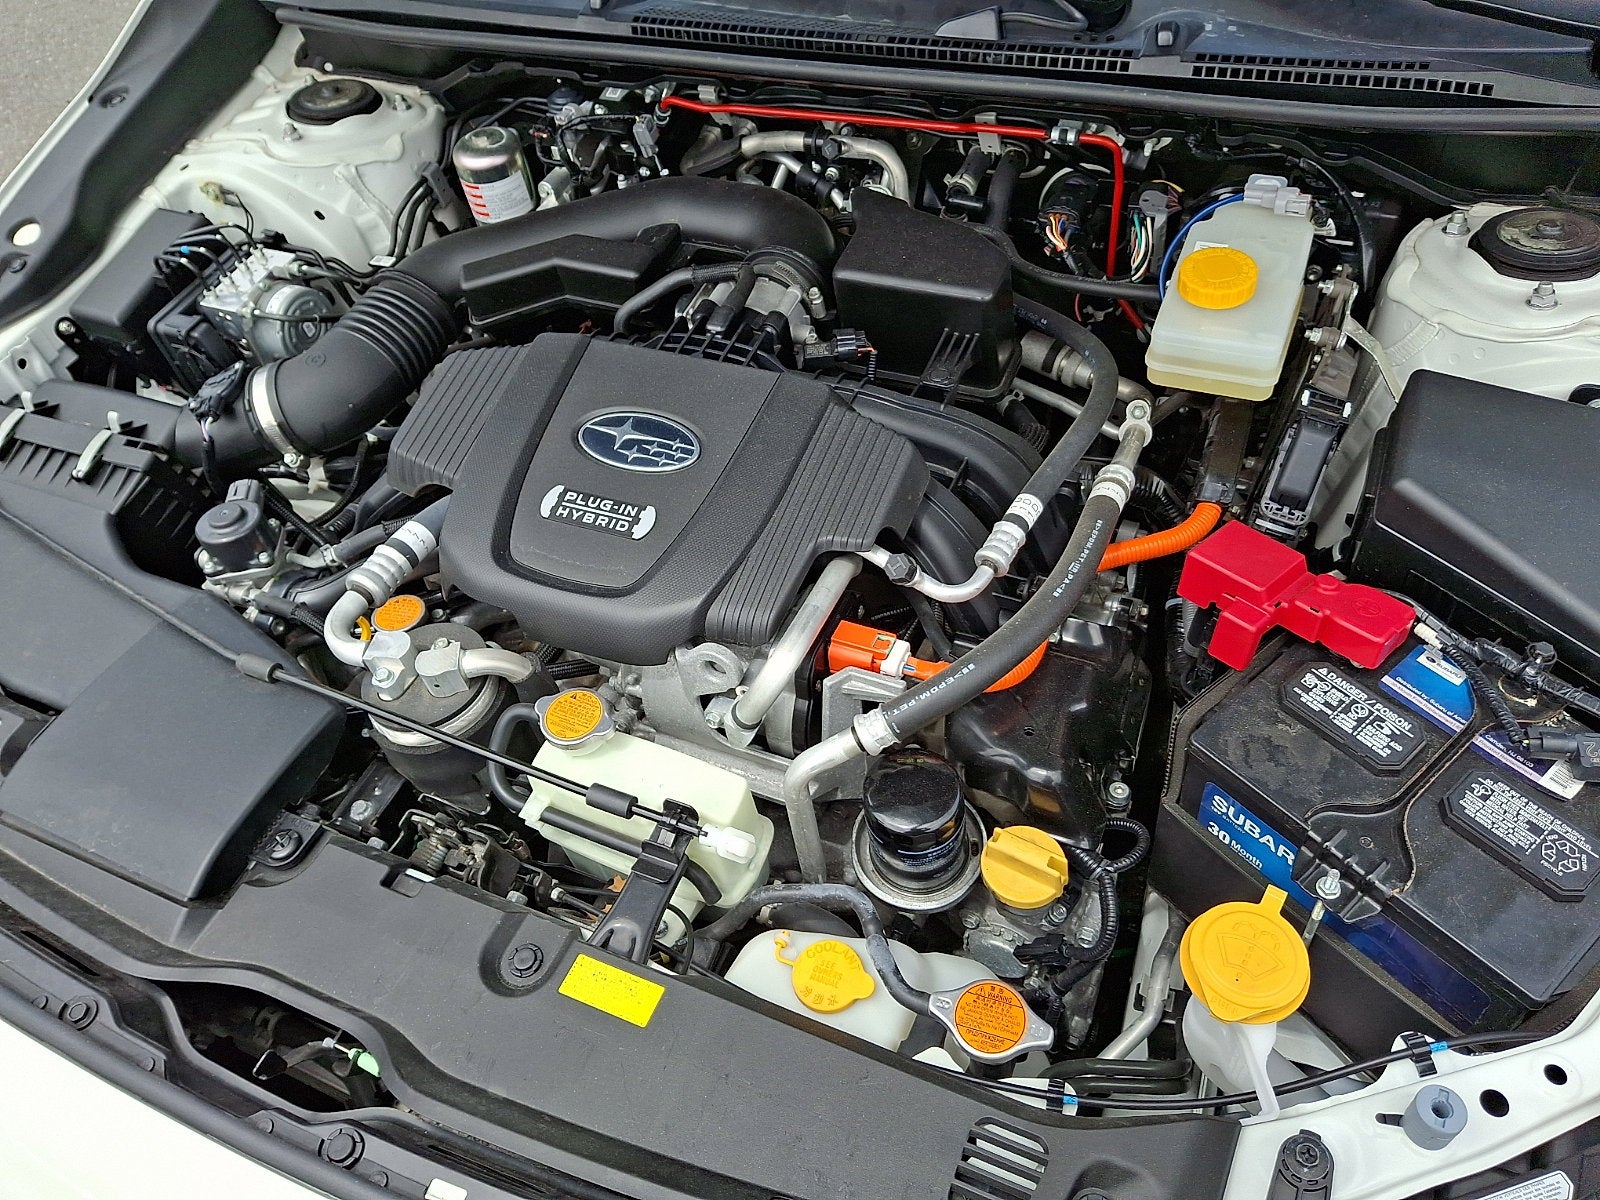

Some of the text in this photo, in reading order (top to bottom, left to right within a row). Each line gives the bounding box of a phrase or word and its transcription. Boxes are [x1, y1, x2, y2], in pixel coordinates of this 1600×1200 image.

[563, 491, 638, 517] PLUG-IN
[555, 506, 630, 532] HYBRID
[1326, 671, 1368, 700] DANGER
[1372, 702, 1413, 730] POISON
[1451, 713, 1468, 725] Amer
[1211, 795, 1295, 865] SUBAR
[1207, 821, 1263, 869] 30 Month
[806, 941, 861, 971] COOLANT
[988, 991, 1013, 1004] WARNING
